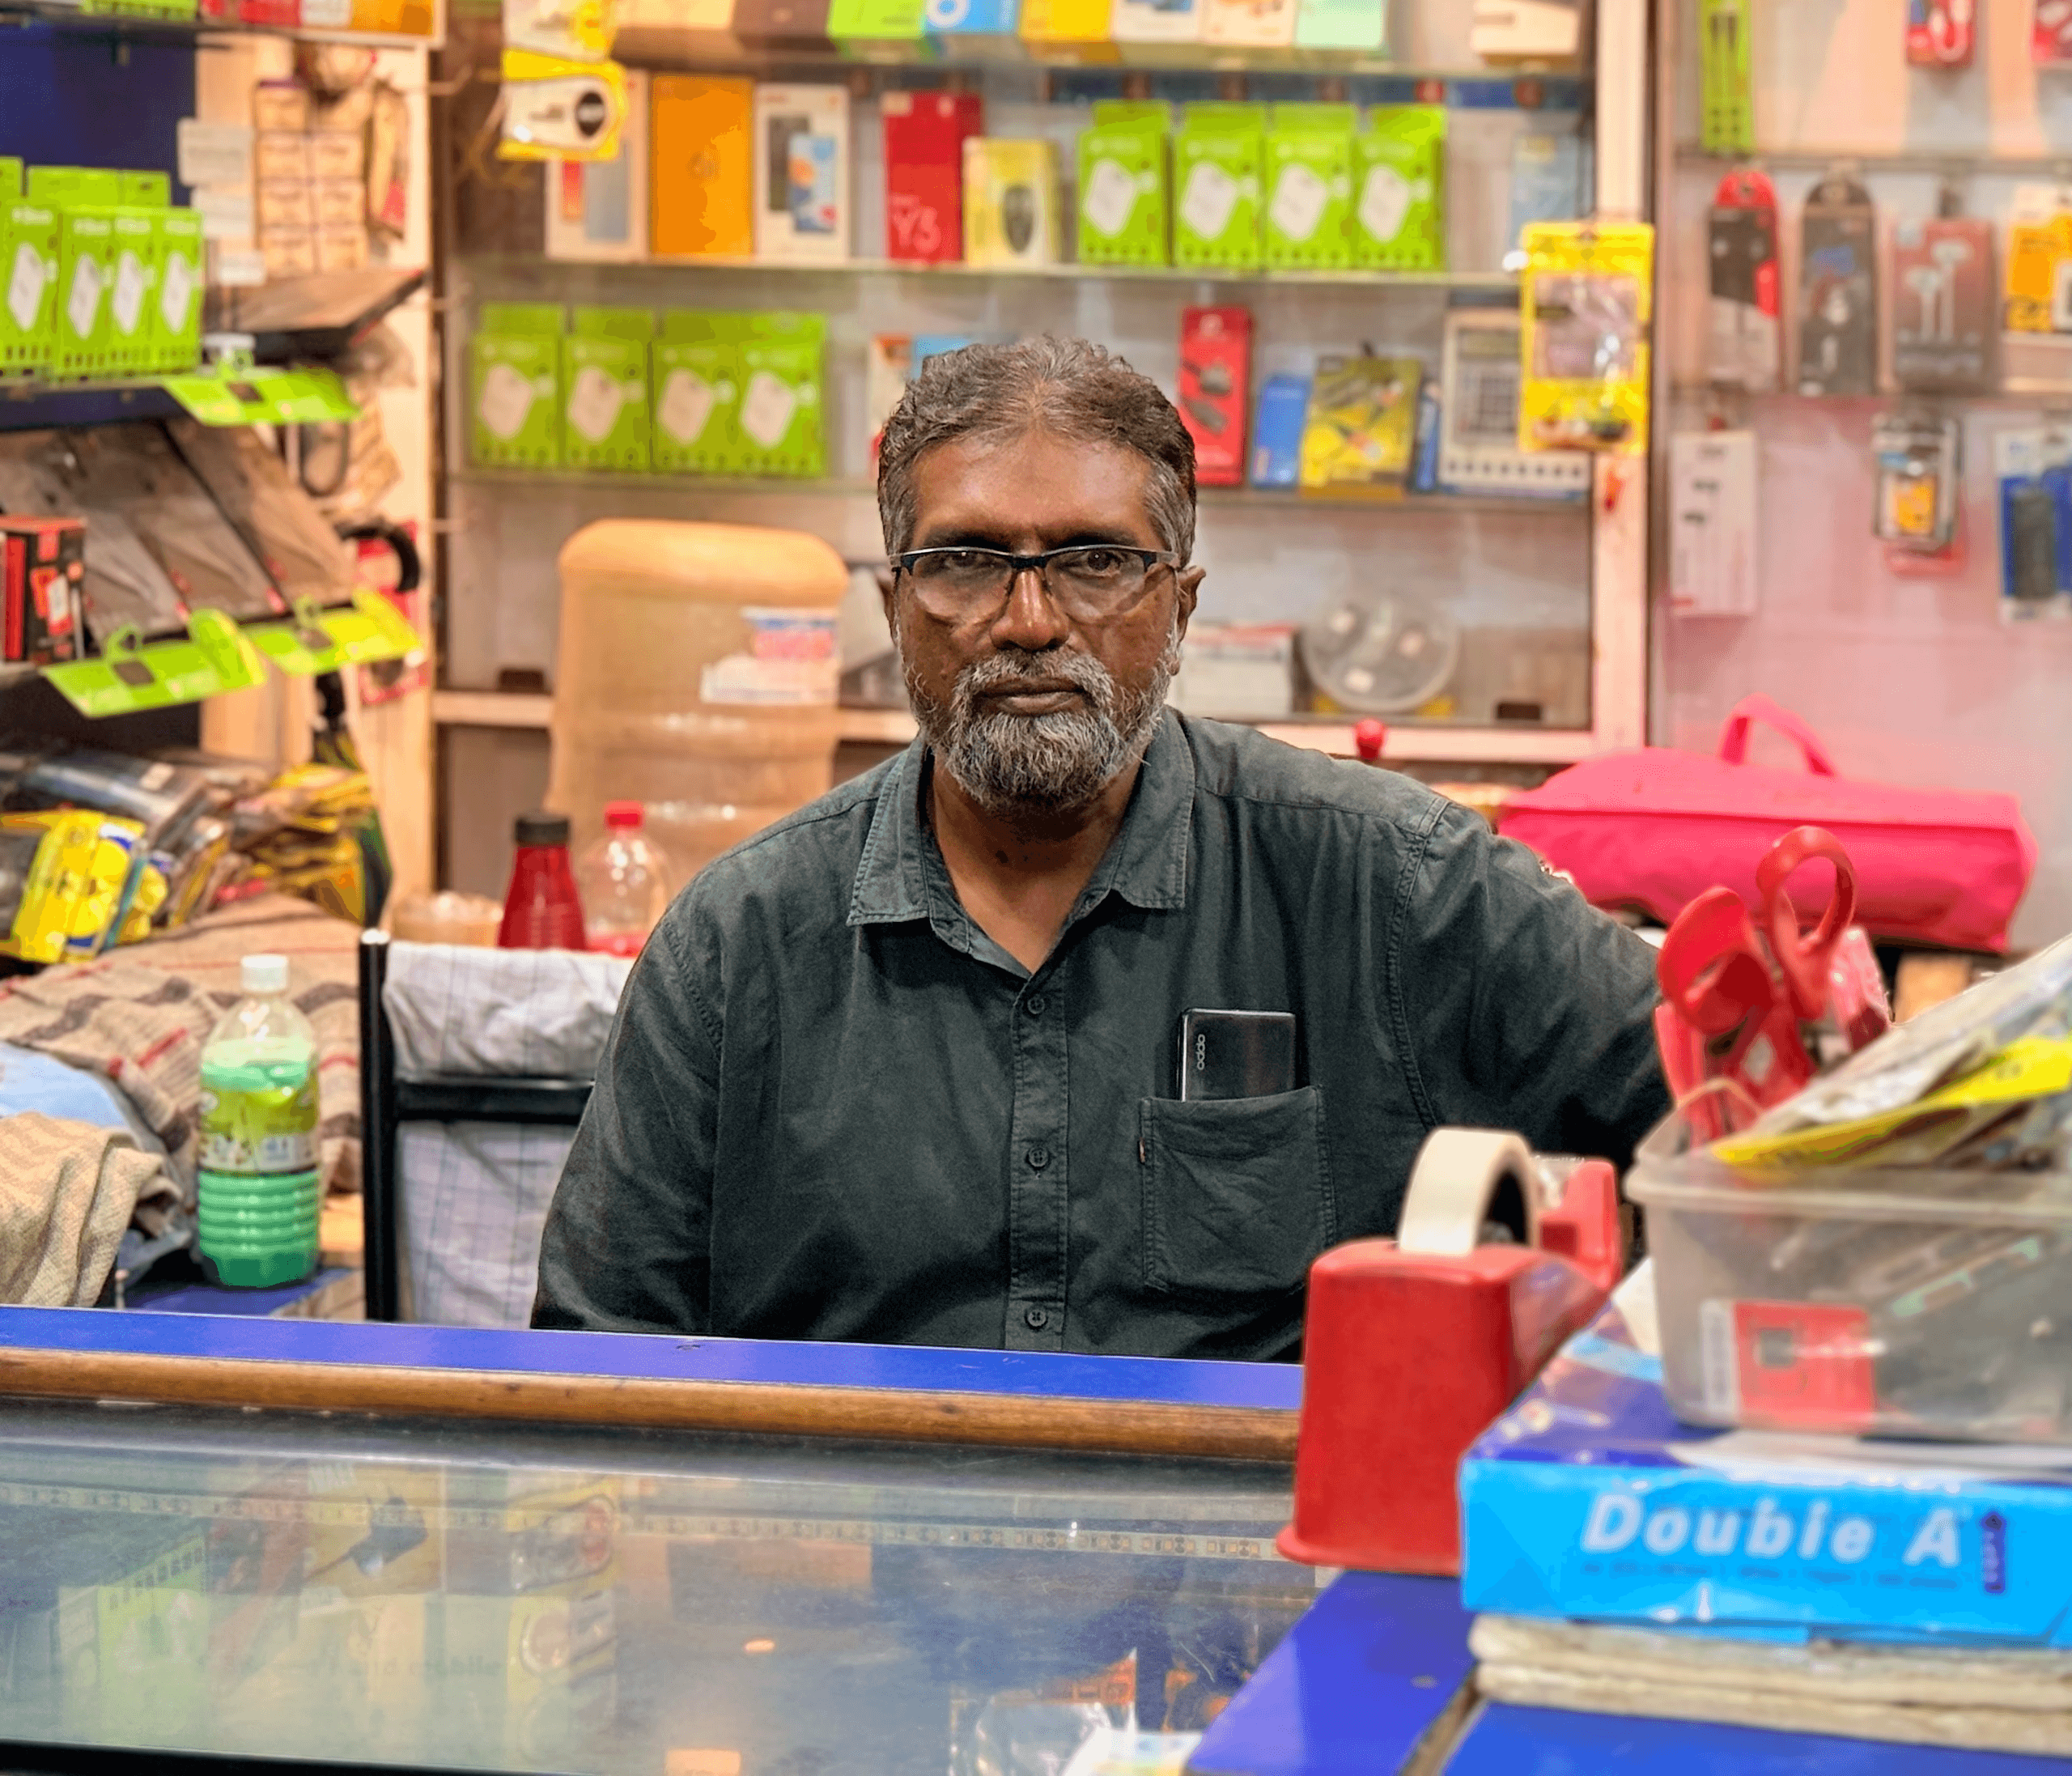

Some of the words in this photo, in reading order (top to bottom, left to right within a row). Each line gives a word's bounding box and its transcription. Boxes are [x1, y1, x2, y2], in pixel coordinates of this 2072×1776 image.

[1196, 1034, 1206, 1070] oppo
[1582, 1492, 1875, 1563] Double
[1903, 1506, 1961, 1567] A
